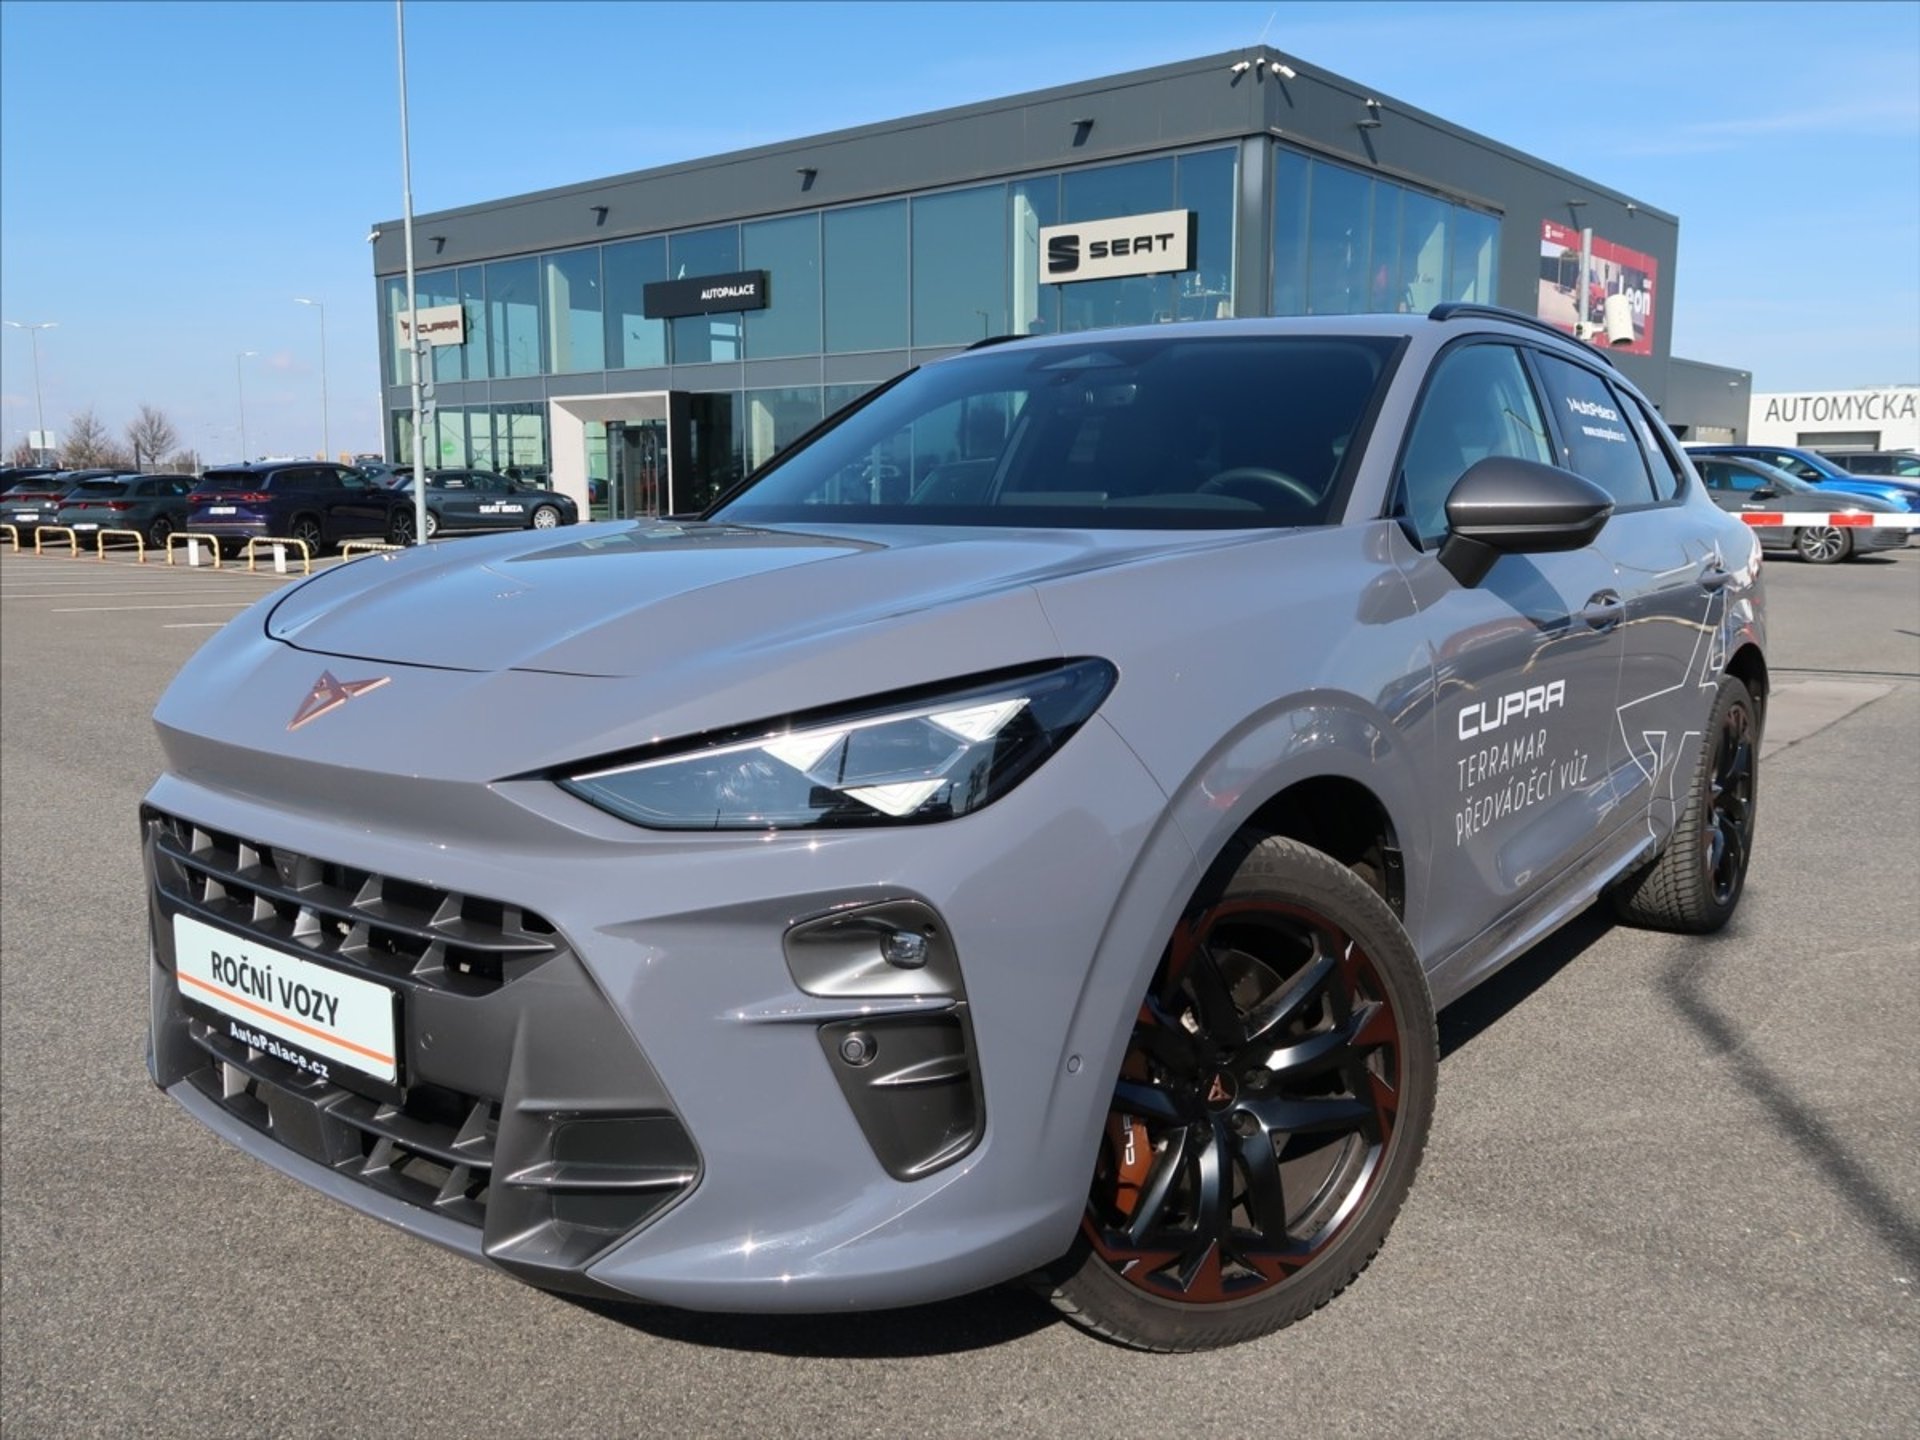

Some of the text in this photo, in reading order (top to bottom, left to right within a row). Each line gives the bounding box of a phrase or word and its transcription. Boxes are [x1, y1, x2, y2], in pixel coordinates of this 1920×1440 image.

[1089, 232, 1175, 259] SEAT
[700, 283, 755, 300] AUTOPALACE
[416, 319, 459, 333] CUPRA
[1764, 391, 1917, 423] AUTOMYČKA
[1458, 679, 1566, 741] CUPRA
[1457, 729, 1547, 792] TERRAMAR
[1455, 748, 1588, 847] PŘEDVÁDĚCÍ VŮZ
[211, 950, 340, 1027] ROČNÍ VOZY
[229, 1021, 330, 1079] AutoPalace.cz
[1122, 1113, 1135, 1166] CUP
